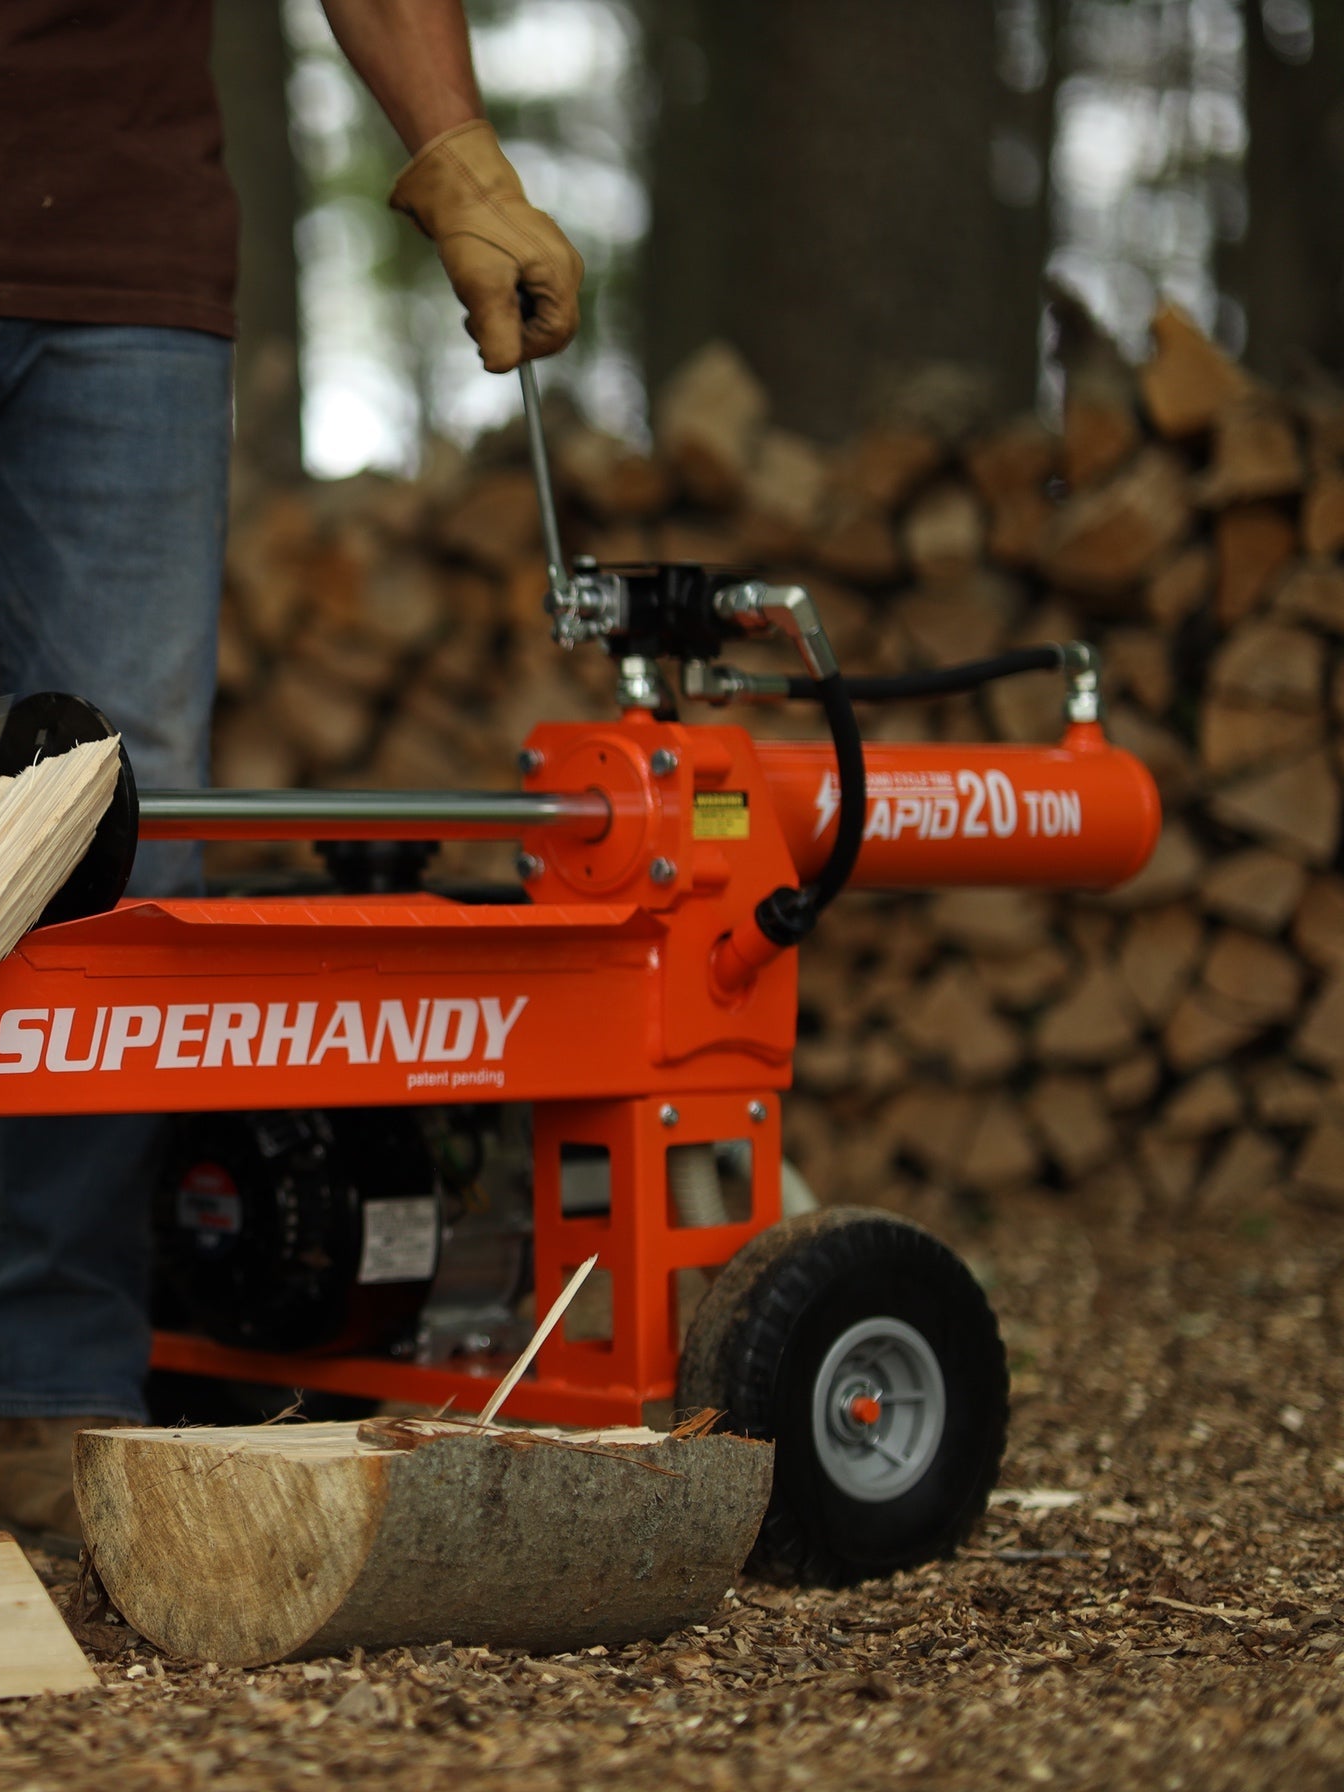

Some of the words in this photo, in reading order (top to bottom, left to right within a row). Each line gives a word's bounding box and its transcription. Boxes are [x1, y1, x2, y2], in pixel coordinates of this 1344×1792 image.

[864, 798, 959, 840] APID
[959, 769, 1016, 838] 20
[1024, 791, 1081, 837] TON
[407, 1072, 449, 1090] patent
[452, 1069, 504, 1088] pending
